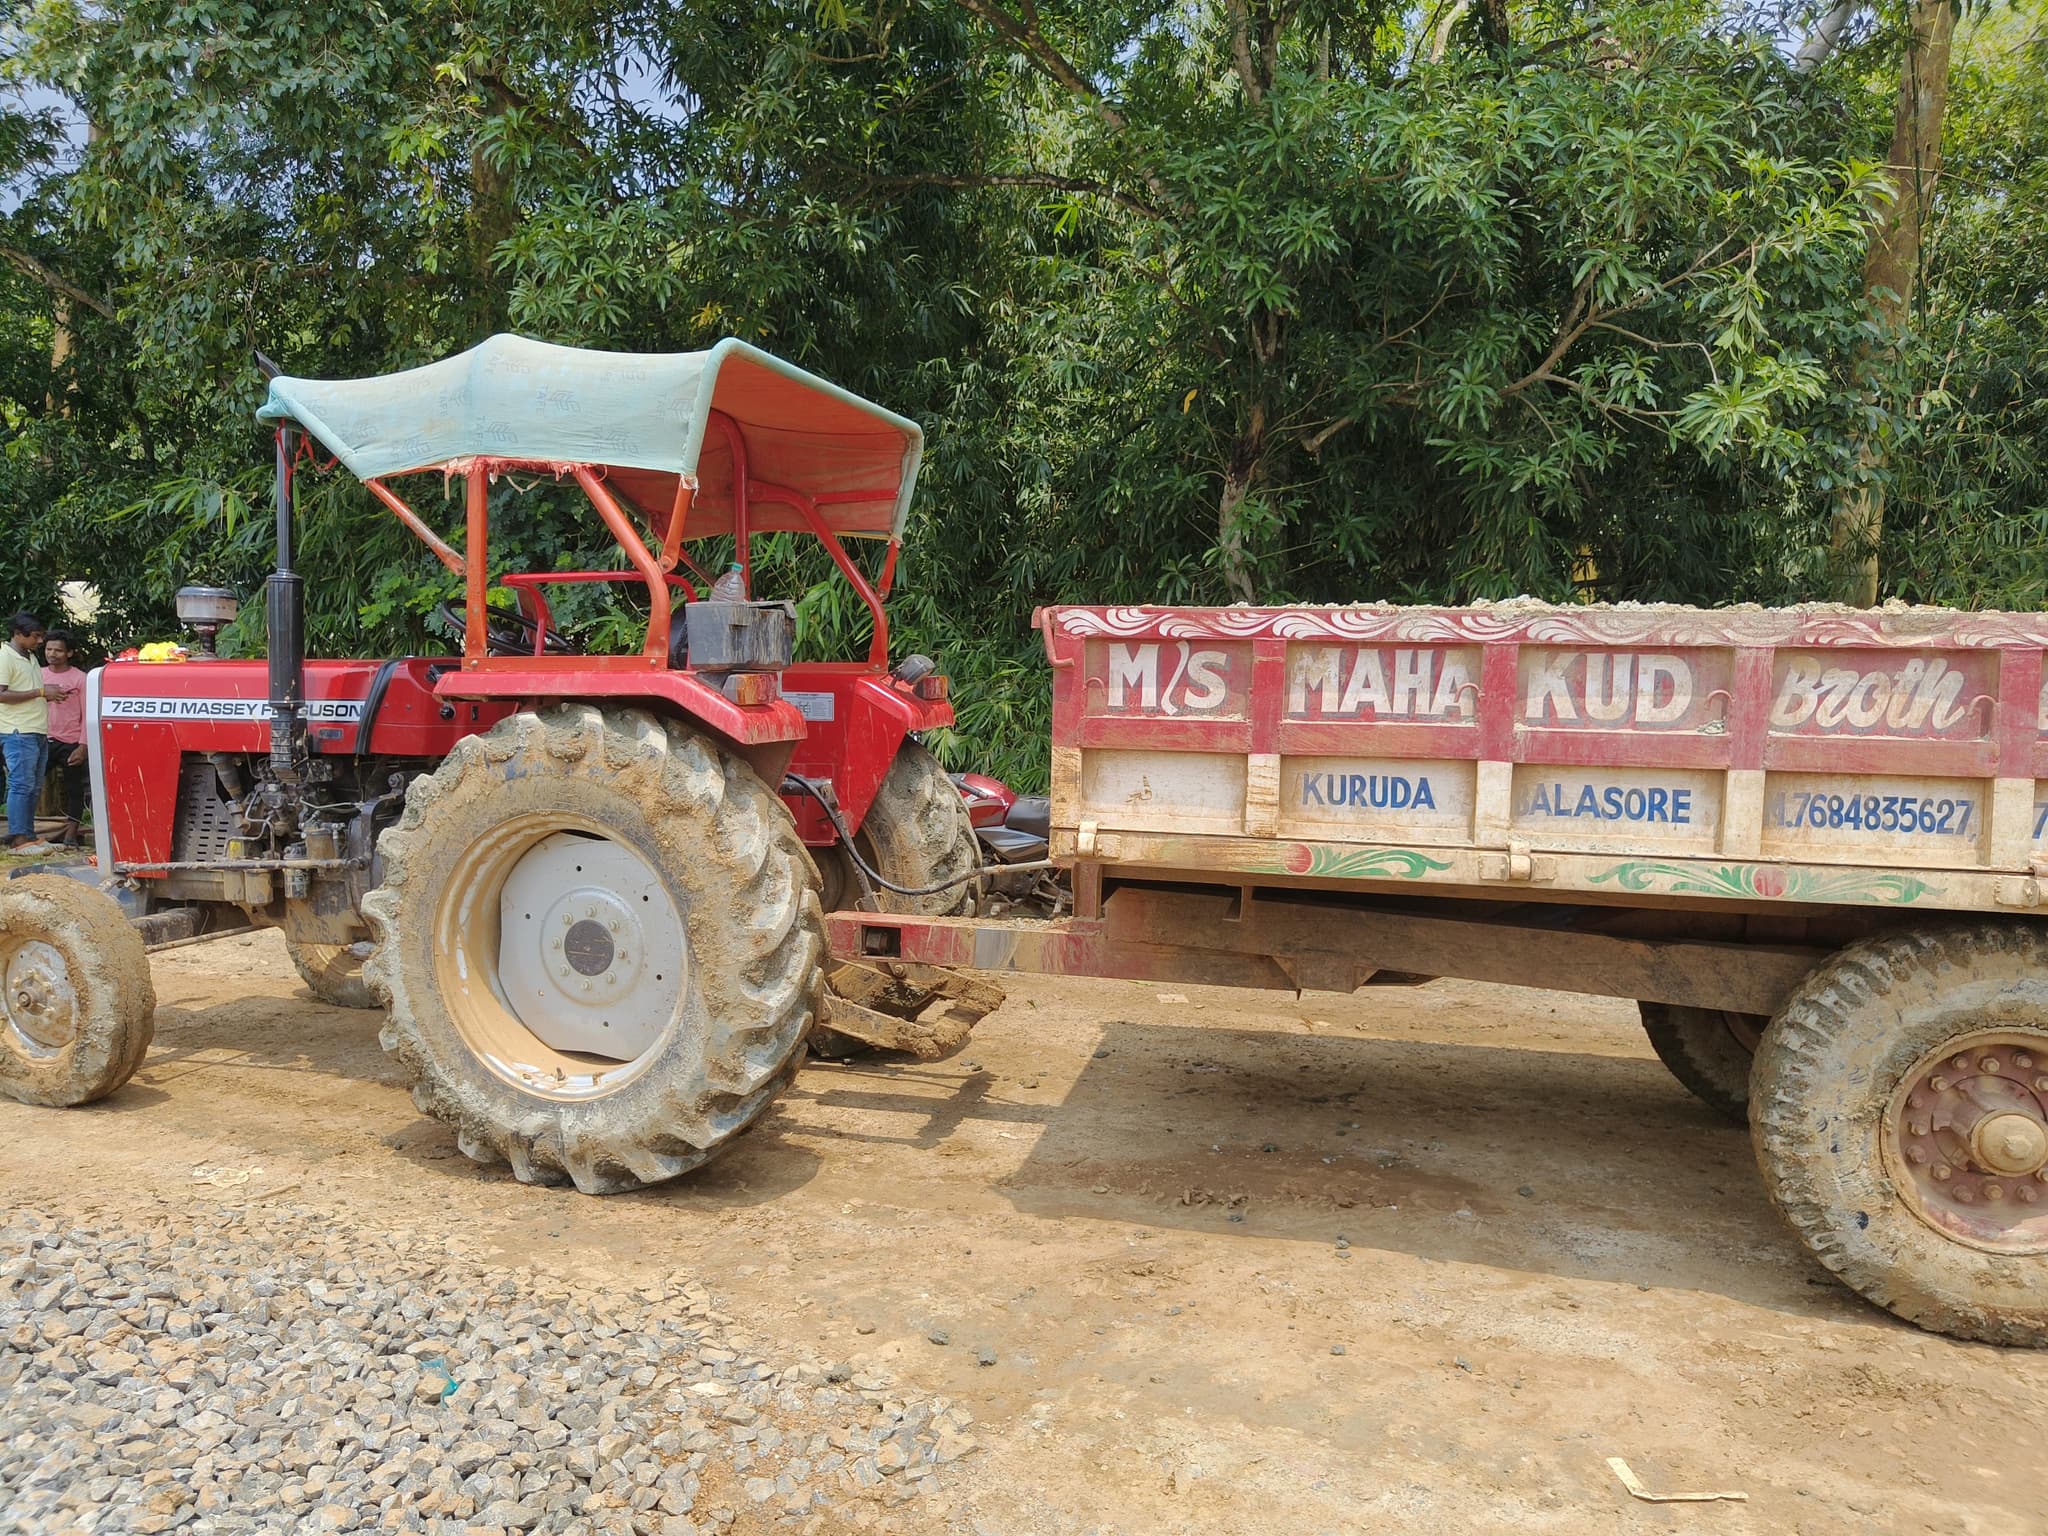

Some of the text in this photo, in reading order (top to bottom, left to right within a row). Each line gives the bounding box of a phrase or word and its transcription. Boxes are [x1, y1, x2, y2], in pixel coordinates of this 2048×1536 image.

[1107, 640, 1229, 716] M/S
[1288, 647, 1476, 717] MAHA
[1525, 653, 1694, 723] KUD
[1769, 656, 1966, 731] Broth
[111, 701, 157, 713] 7235
[160, 702, 176, 714] DI
[180, 702, 256, 716] MASSEY
[1302, 772, 1436, 810] KURUDA
